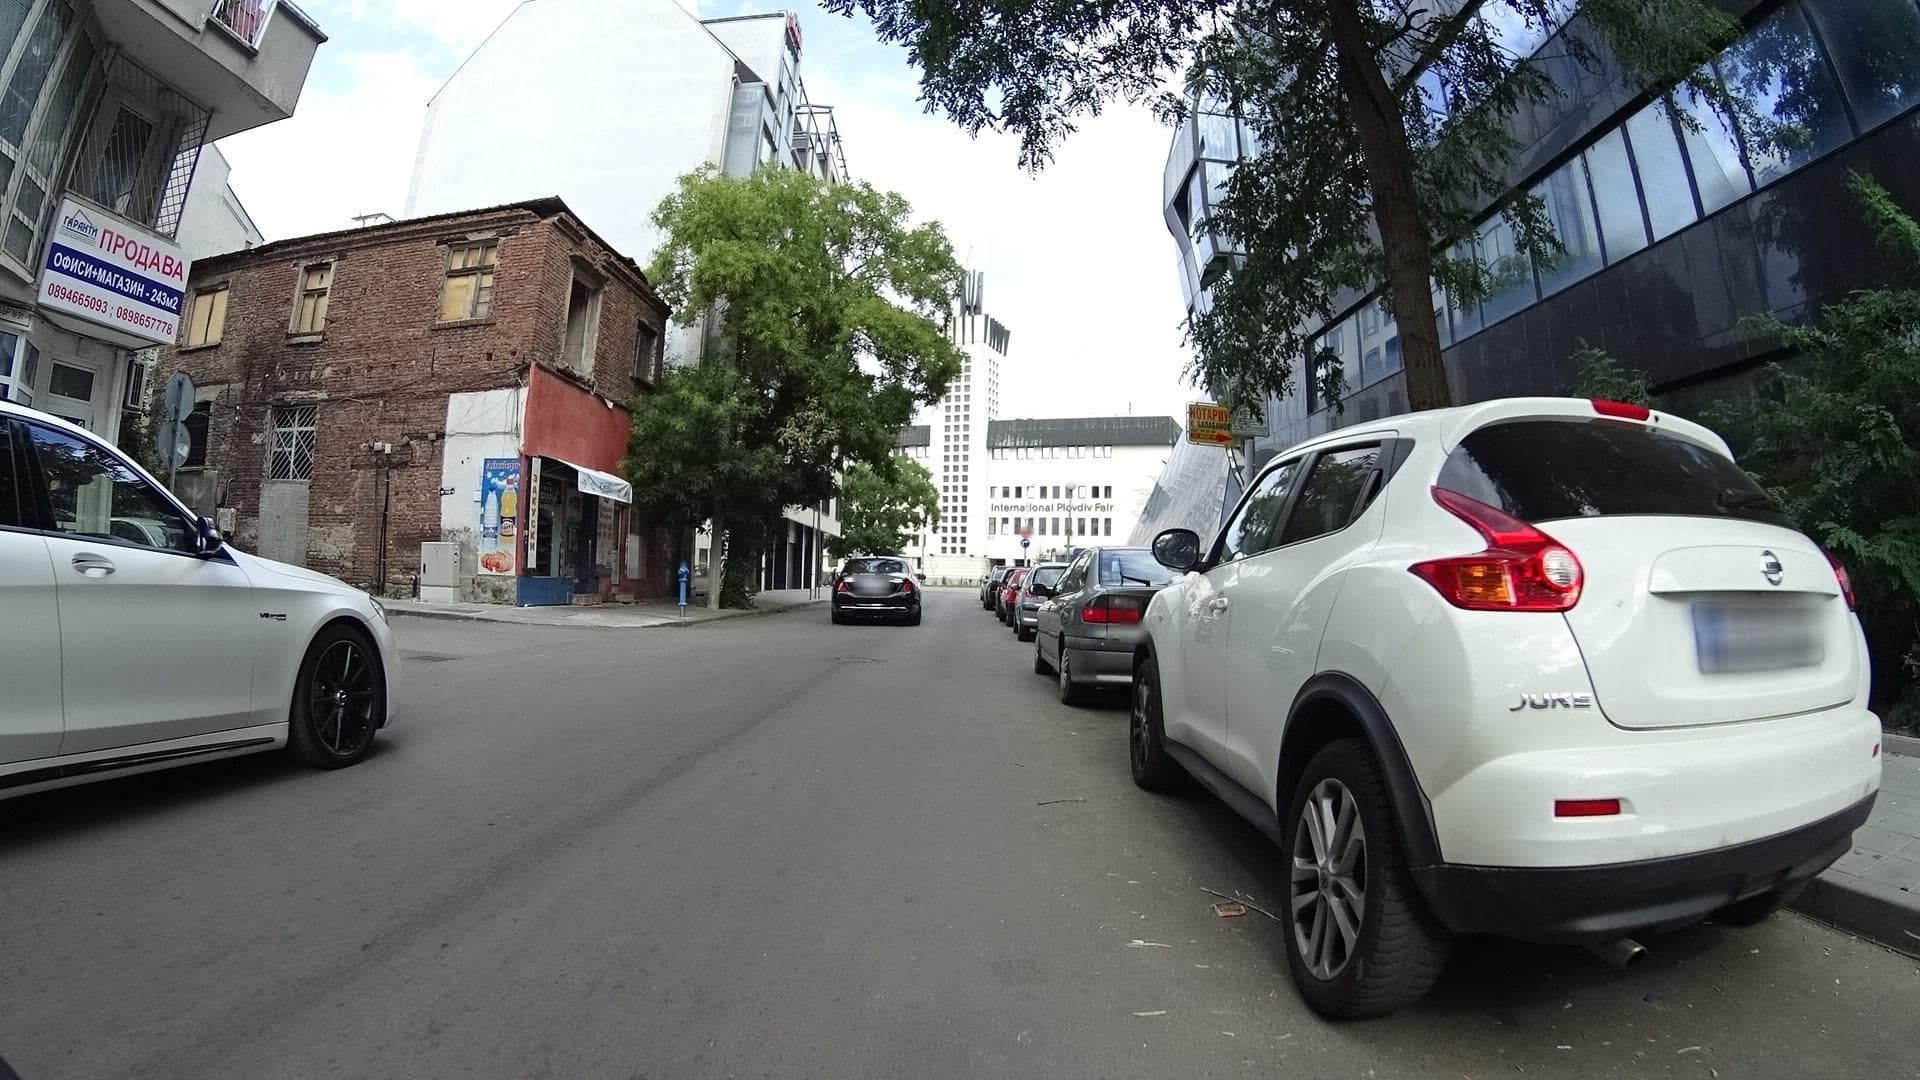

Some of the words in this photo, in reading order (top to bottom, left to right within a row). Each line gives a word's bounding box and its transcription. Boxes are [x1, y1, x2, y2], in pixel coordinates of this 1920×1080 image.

[63, 216, 98, 238] ГАРАНТИ
[53, 252, 145, 298] ОФИСИ+МАГАЗИН
[150, 288, 179, 310] 243м2
[99, 229, 183, 281] ПРОДАВА
[48, 283, 108, 314] 0894665093
[116, 306, 173, 335] 0898657778
[529, 474, 538, 553] ЗАКУСКИ
[991, 503, 1054, 512] International
[1056, 503, 1092, 512] Plovdiv
[1095, 503, 1114, 512] Fair
[1509, 692, 1591, 711] JUKE
